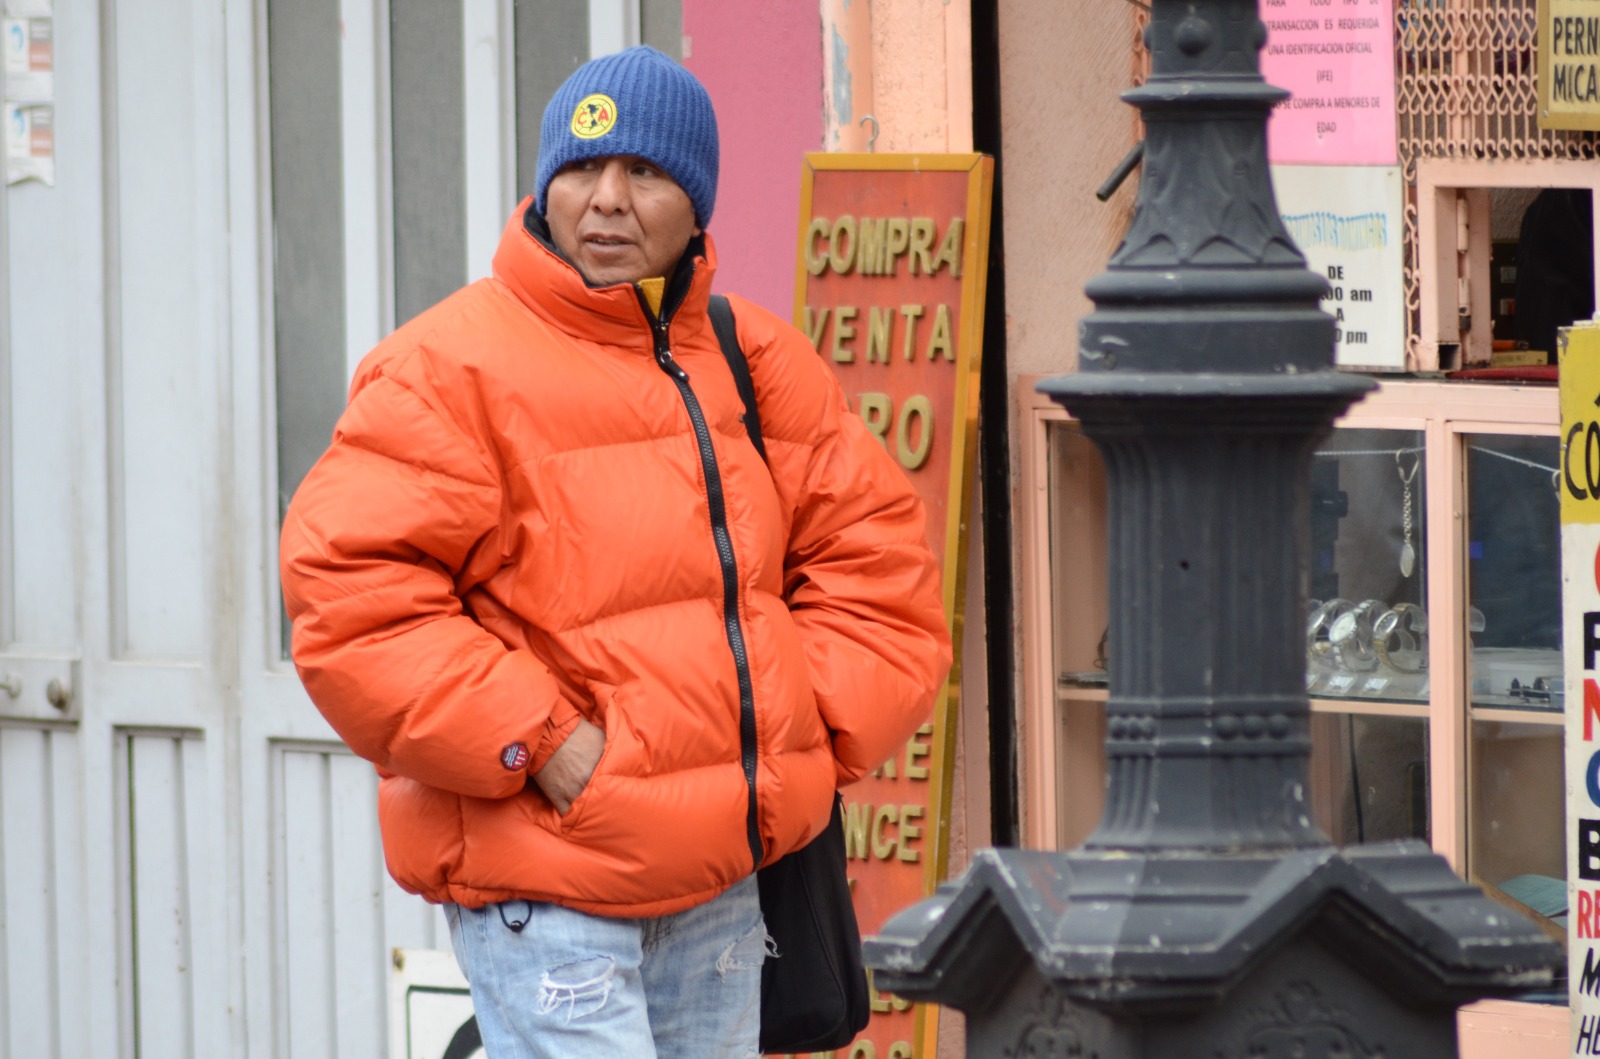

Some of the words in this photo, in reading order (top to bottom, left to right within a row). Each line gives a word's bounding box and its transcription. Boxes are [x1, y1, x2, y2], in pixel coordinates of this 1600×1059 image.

[1324, 19, 1333, 30] ES
[1338, 18, 1379, 30] REQUERIDA
[1267, 44, 1284, 55] UNA
[1286, 42, 1343, 54] IDENTIFICACION
[1345, 42, 1372, 53] OFICIAL
[1316, 70, 1333, 82] (IFE)
[1293, 98, 1325, 109] COMPRA
[1327, 99, 1332, 109] A
[1334, 97, 1369, 108] MENORES
[1371, 97, 1380, 107] DE
[1316, 122, 1336, 133] EDAD
[805, 215, 964, 278] COMPRA
[1328, 266, 1344, 280] DE
[1350, 289, 1372, 301] am
[1336, 308, 1344, 322] A
[804, 304, 955, 364] VENTA
[1346, 331, 1367, 345] pm
